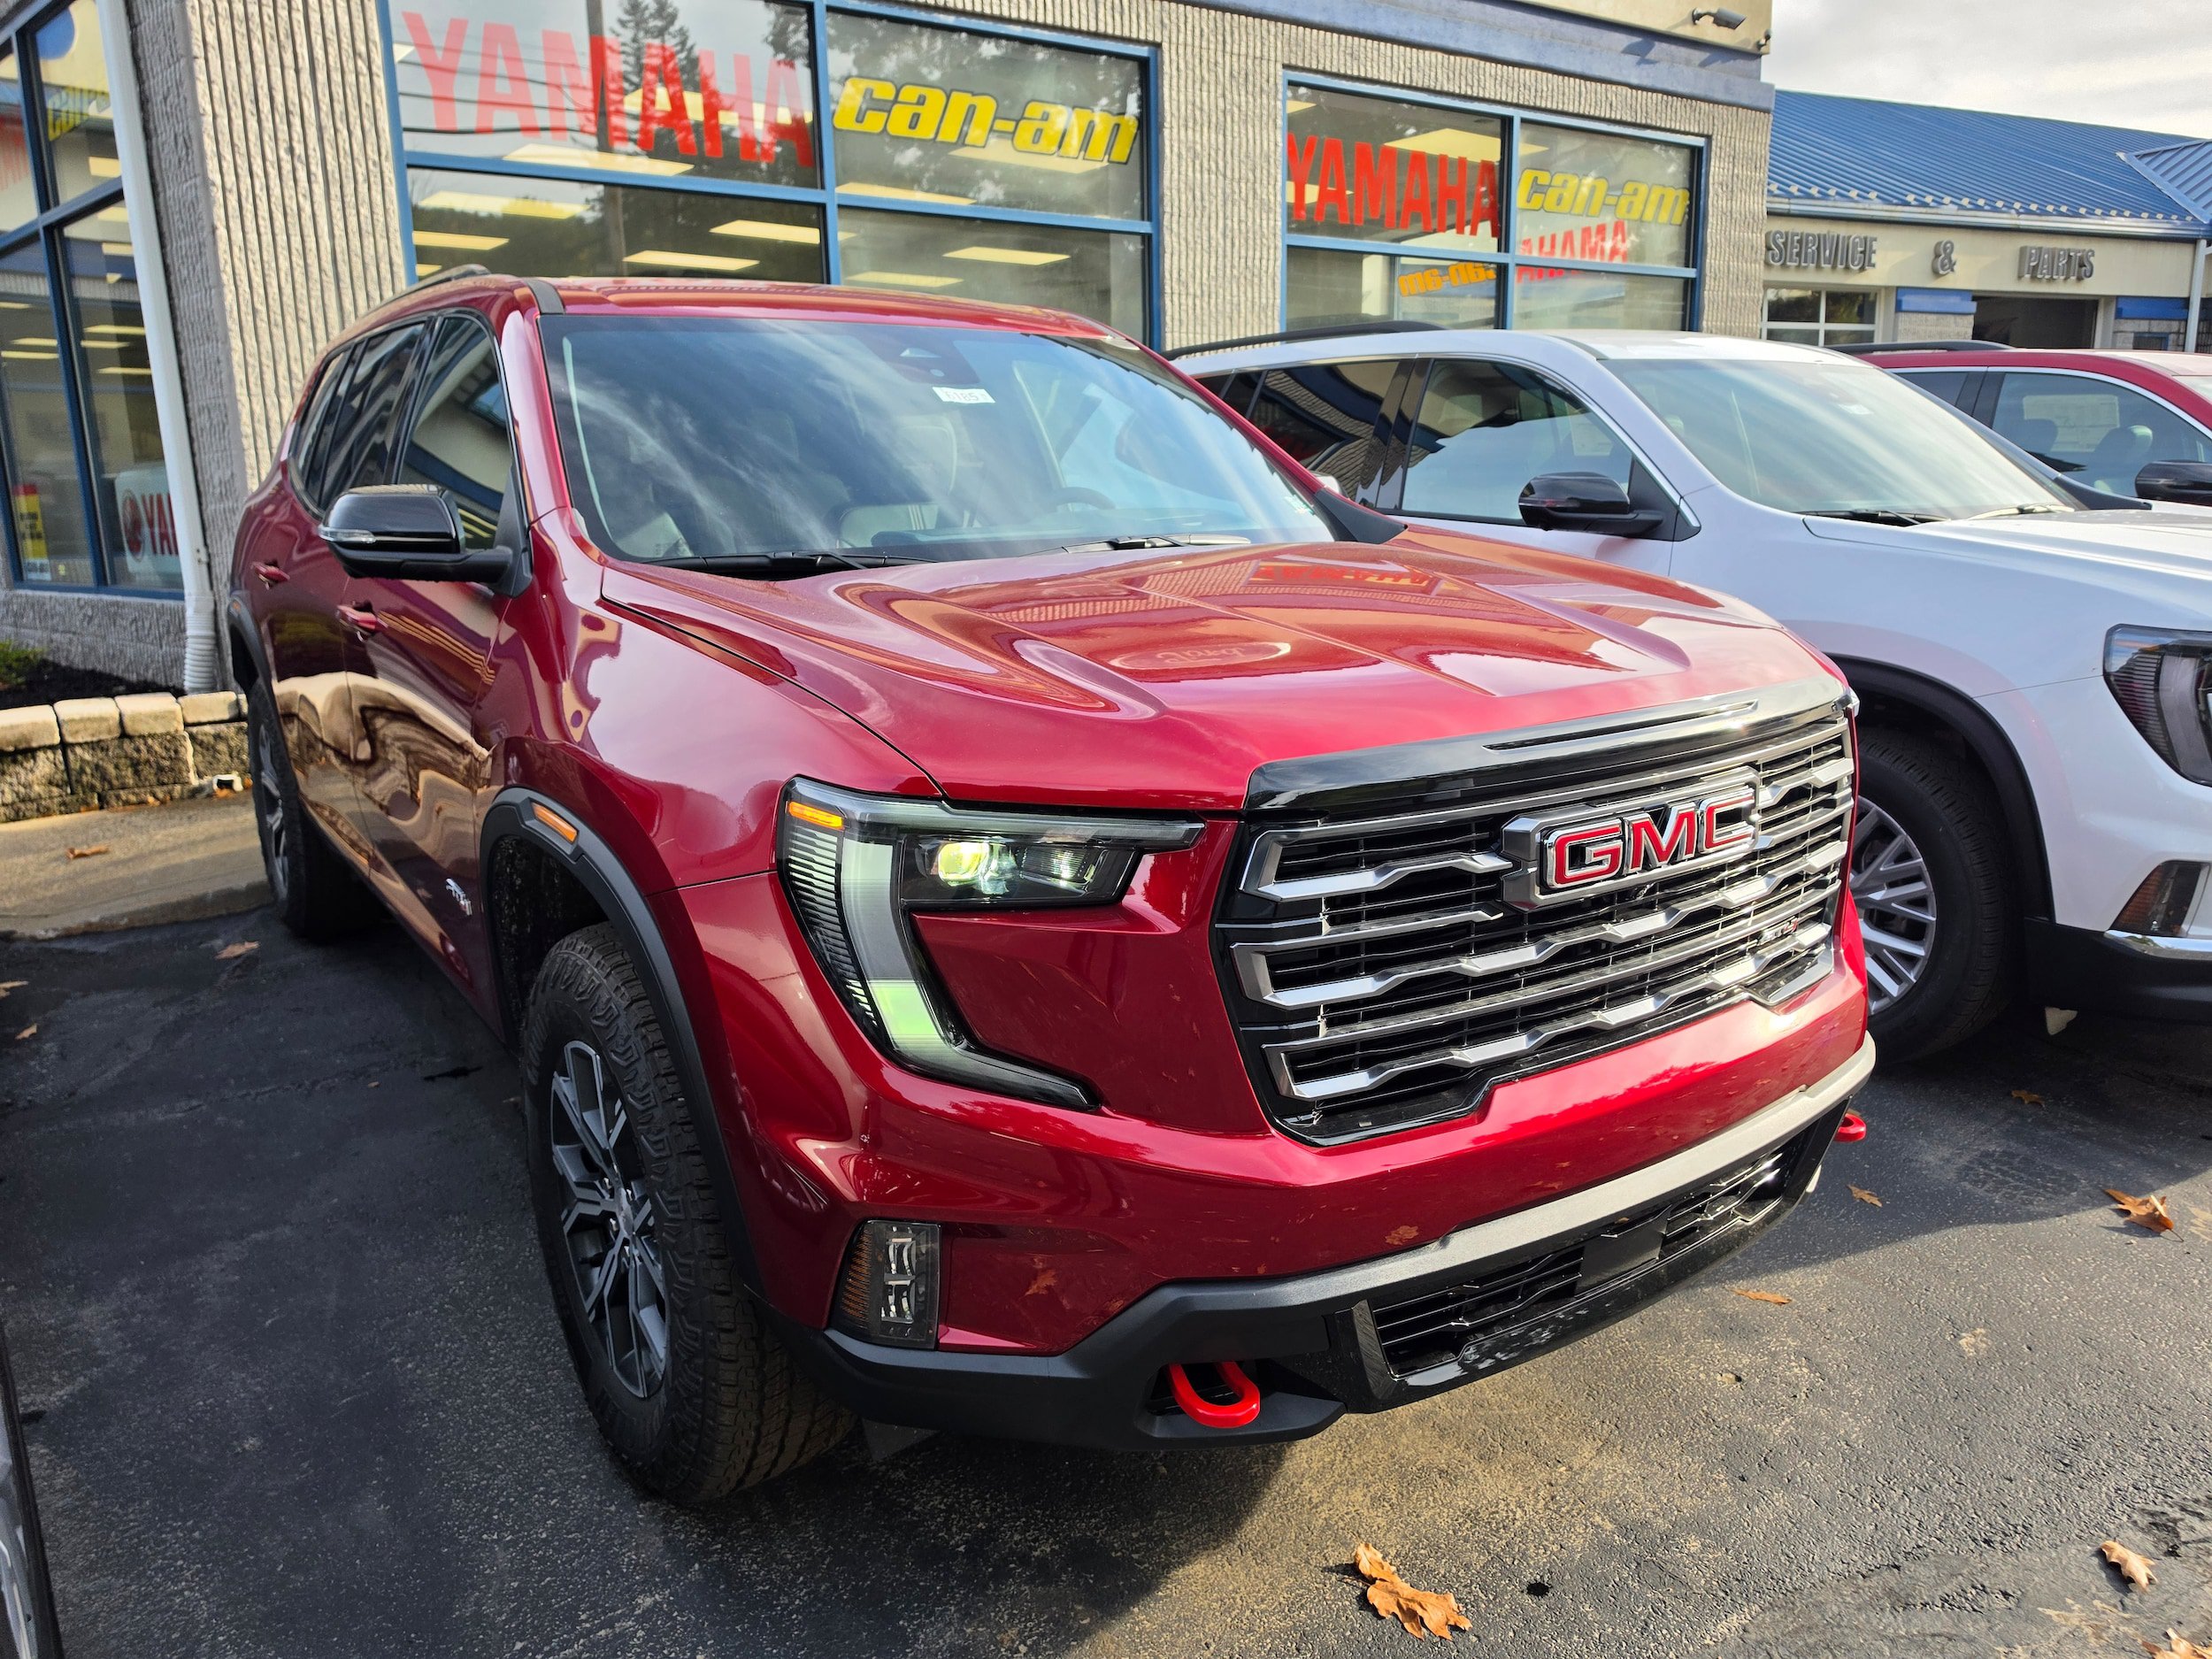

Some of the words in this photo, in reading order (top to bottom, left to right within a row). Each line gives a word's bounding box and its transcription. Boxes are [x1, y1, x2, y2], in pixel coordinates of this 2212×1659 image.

[401, 11, 816, 168] YAMAHA
[833, 76, 1140, 165] can-am
[1287, 133, 1502, 239] YAMAHA
[1517, 167, 1691, 227] can-am
[1765, 229, 1878, 269] SERVICE
[1932, 240, 1956, 275] &
[2019, 246, 2095, 280] PARTS
[1547, 788, 1756, 889] GMC
